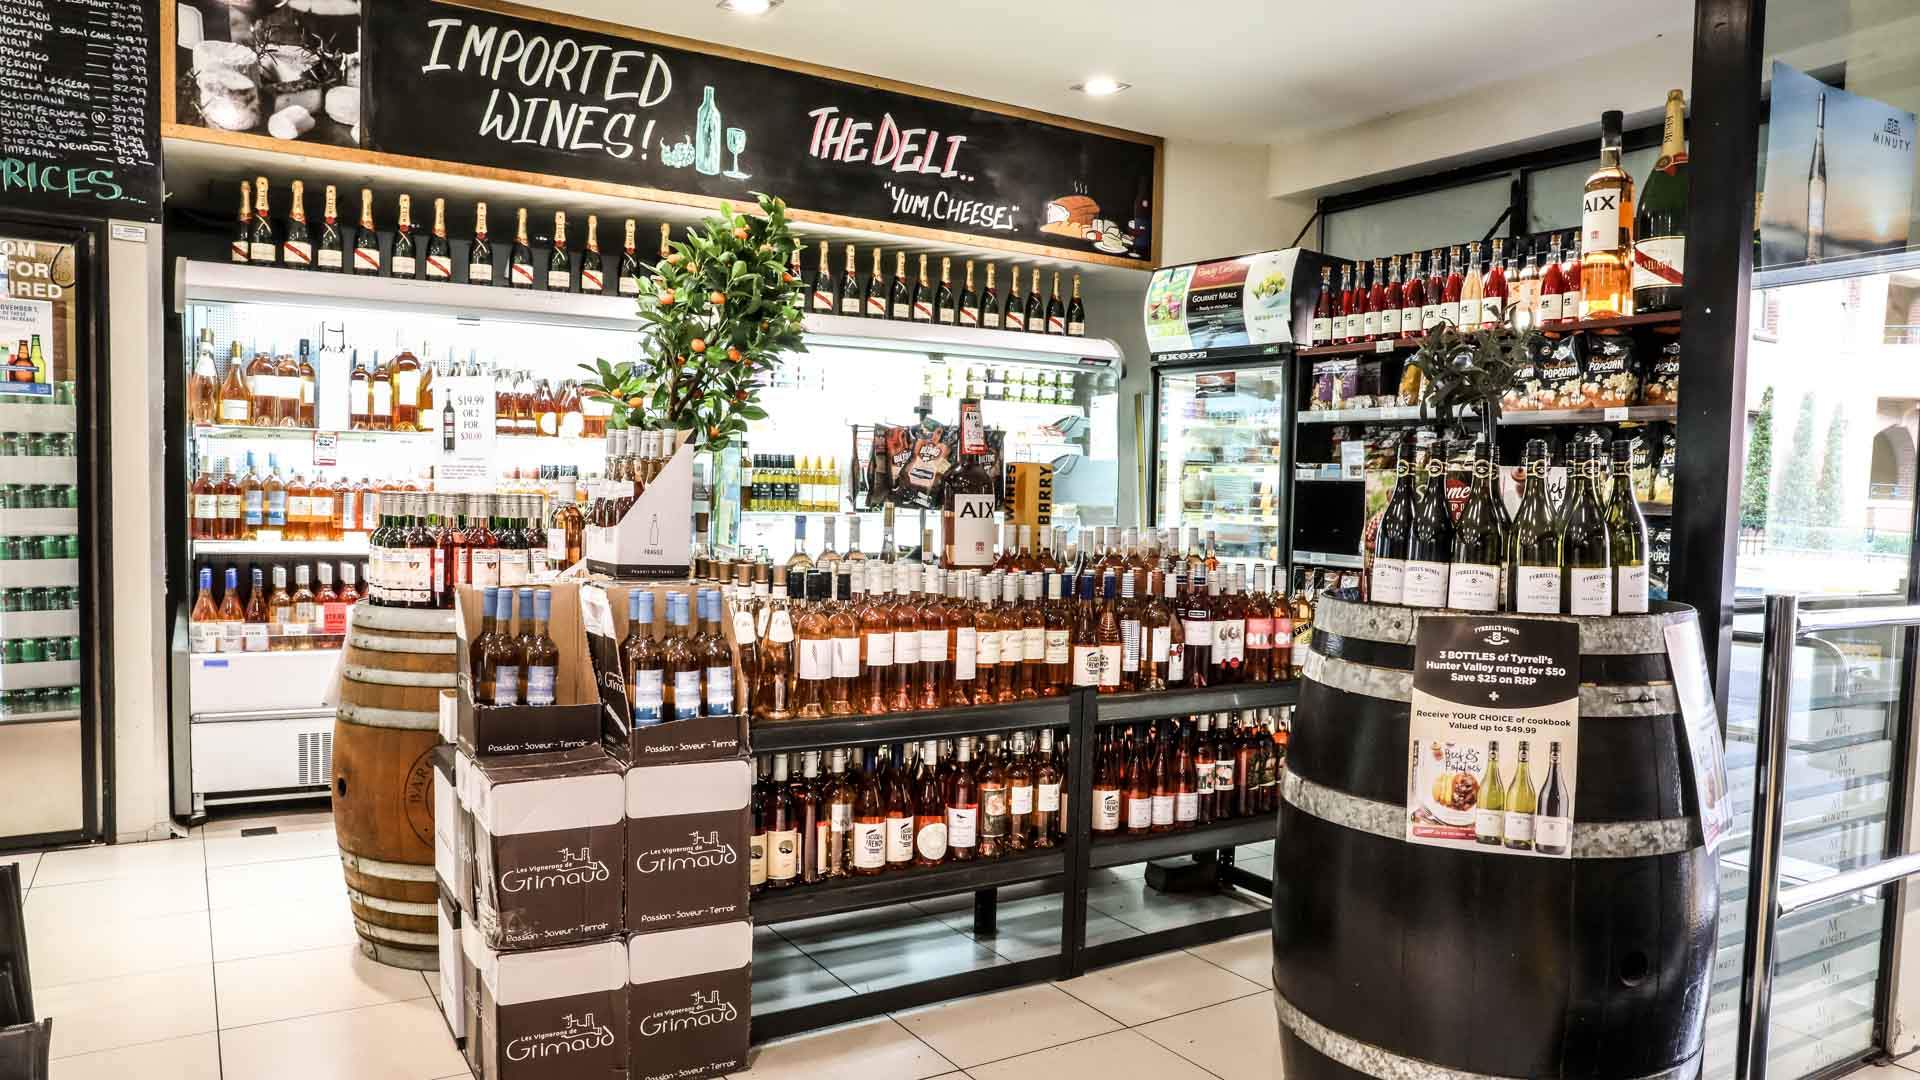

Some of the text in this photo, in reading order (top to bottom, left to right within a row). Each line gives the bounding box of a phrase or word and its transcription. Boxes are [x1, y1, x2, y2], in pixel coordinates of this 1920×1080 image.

[0, 46, 48, 61] PACIFICO
[0, 56, 42, 72] PERONI
[422, 18, 672, 107] IMPORTED
[0, 67, 37, 80] PERONI
[0, 77, 42, 91] STELLA
[49, 86, 90, 101] ARTOIS
[480, 88, 656, 160] WINES!
[808, 106, 873, 162] THE
[1873, 132, 1911, 152] MINUTY
[4, 144, 57, 159] IMPERIAL
[1584, 195, 1614, 214] AIX
[1192, 291, 1237, 303] GOURMET MEALS
[0, 304, 32, 312] OVEMBER
[1158, 351, 1207, 362] SKOPE
[1589, 360, 1624, 372] POPCORN
[1655, 363, 1680, 373] POPCO
[960, 502, 994, 518] AIX
[1439, 651, 1553, 665] 3 BOTTLES of Tyrrell's
[1426, 661, 1566, 677] Hunter Valley range for $50
[1451, 673, 1475, 682] Save
[1477, 674, 1497, 684] $25
[1514, 677, 1537, 686] RRP
[1416, 710, 1571, 727] Receive YOUR CHOICE of cookbook
[1449, 722, 1537, 734] Valued up to $49.99
[488, 743, 519, 752] Passion
[559, 739, 588, 748] Terroir
[645, 744, 675, 754] Passion
[711, 739, 739, 748] Terroir
[636, 843, 736, 873] Grimaud
[662, 846, 693, 855] Vignerons
[501, 860, 609, 893] Grimaud
[529, 864, 564, 874] Vignerons
[641, 914, 671, 923] Passion
[709, 904, 737, 914] Terroir
[579, 922, 609, 932] Terroir
[664, 1006, 694, 1017] Vignerons
[640, 1002, 737, 1037] Grimaud
[533, 1030, 568, 1040] Vignerons
[506, 1025, 614, 1062] Grimaud
[709, 1059, 737, 1070] Terroir
